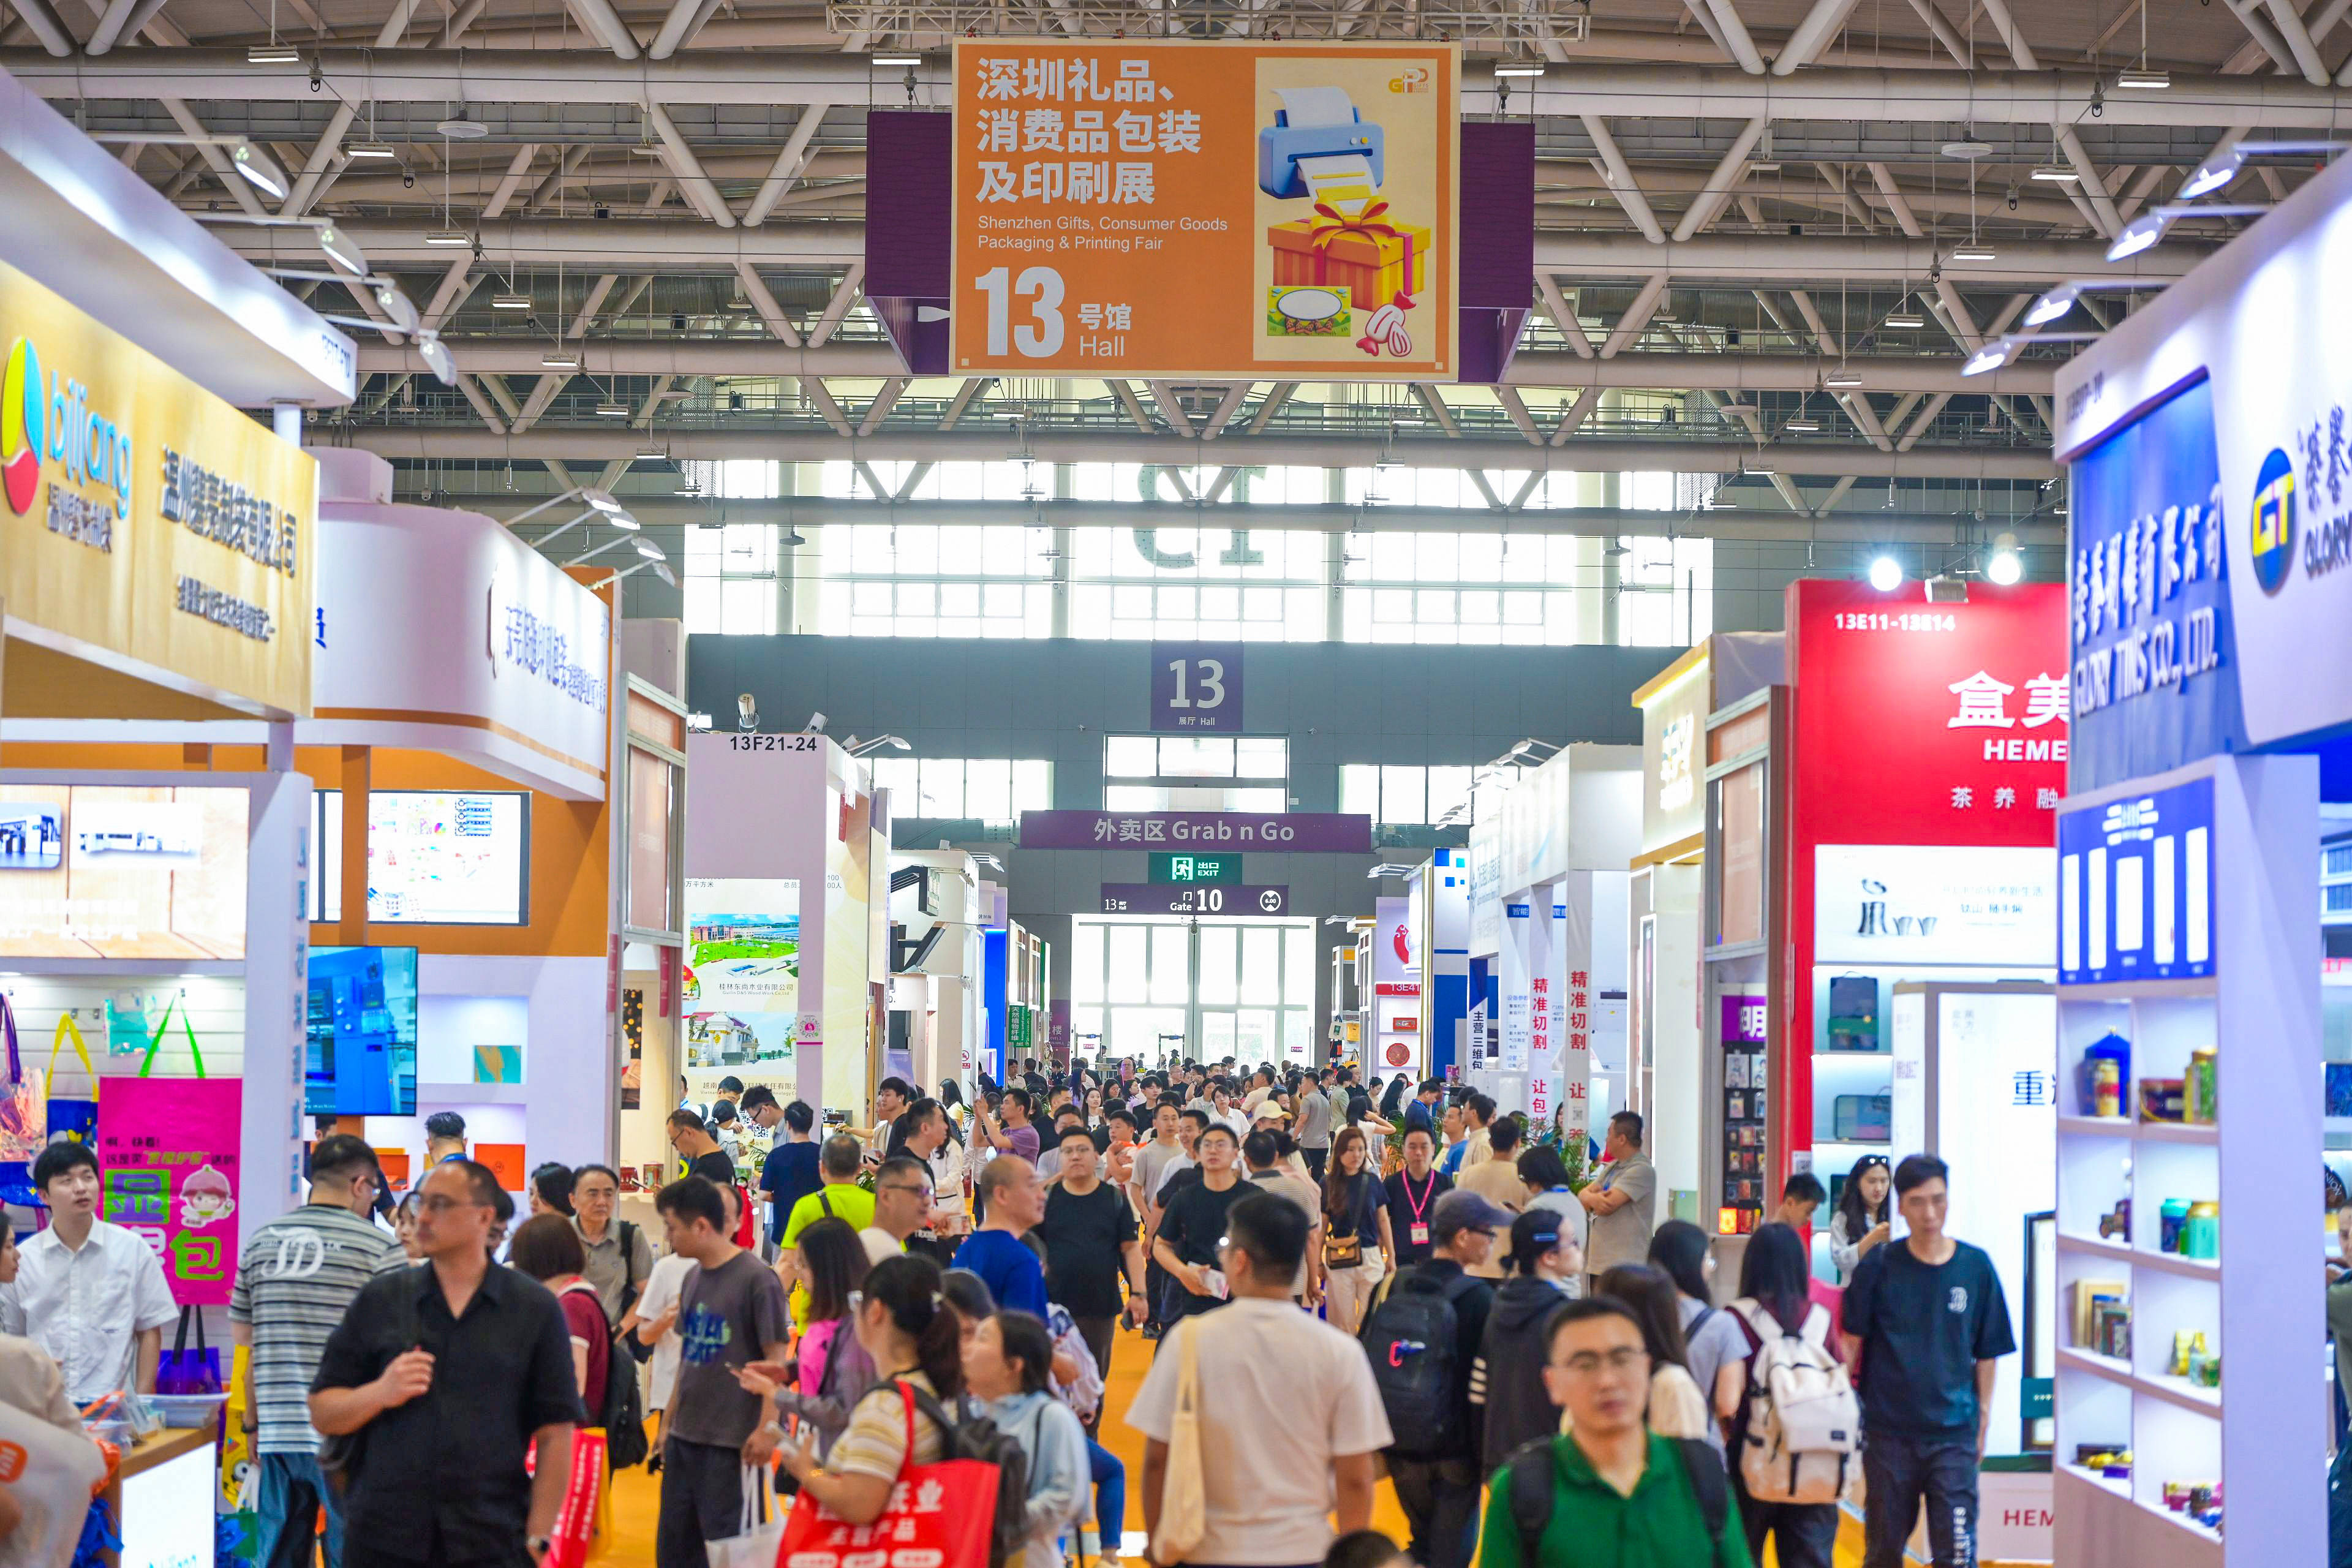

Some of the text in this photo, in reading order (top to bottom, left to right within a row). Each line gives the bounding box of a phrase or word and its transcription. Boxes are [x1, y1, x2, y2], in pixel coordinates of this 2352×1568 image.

[977, 58, 1174, 102] 深圳礼品、
[977, 108, 1201, 154] 消费品包装
[976, 161, 1155, 205] 及印刷展
[978, 215, 1228, 231] Shenzhen Gifts, Consumer Goods
[978, 235, 1163, 252] Packaging & Printing Fair
[975, 266, 1066, 358] 13
[1077, 303, 1132, 330] 号馆
[1079, 335, 1125, 356] Hall
[1835, 613, 1956, 631] 13E11-13E14
[1169, 659, 1225, 709] 13
[1947, 671, 2069, 729] 盒美
[1178, 717, 1215, 726] 展厅 Hall
[729, 735, 818, 752] 13F21-24
[1984, 739, 2068, 761] HEME
[1094, 818, 1295, 842] 外卖区 Grab n Go
[1104, 899, 1117, 910] 13
[1169, 889, 1223, 911] Gate 10
[1183, 891, 1193, 901] 门
[1390, 983, 1420, 992] 13E41
[1532, 978, 1549, 1050] 精准切割
[1569, 971, 1588, 1050] 精准切割
[2004, 1509, 2054, 1526] HEM
